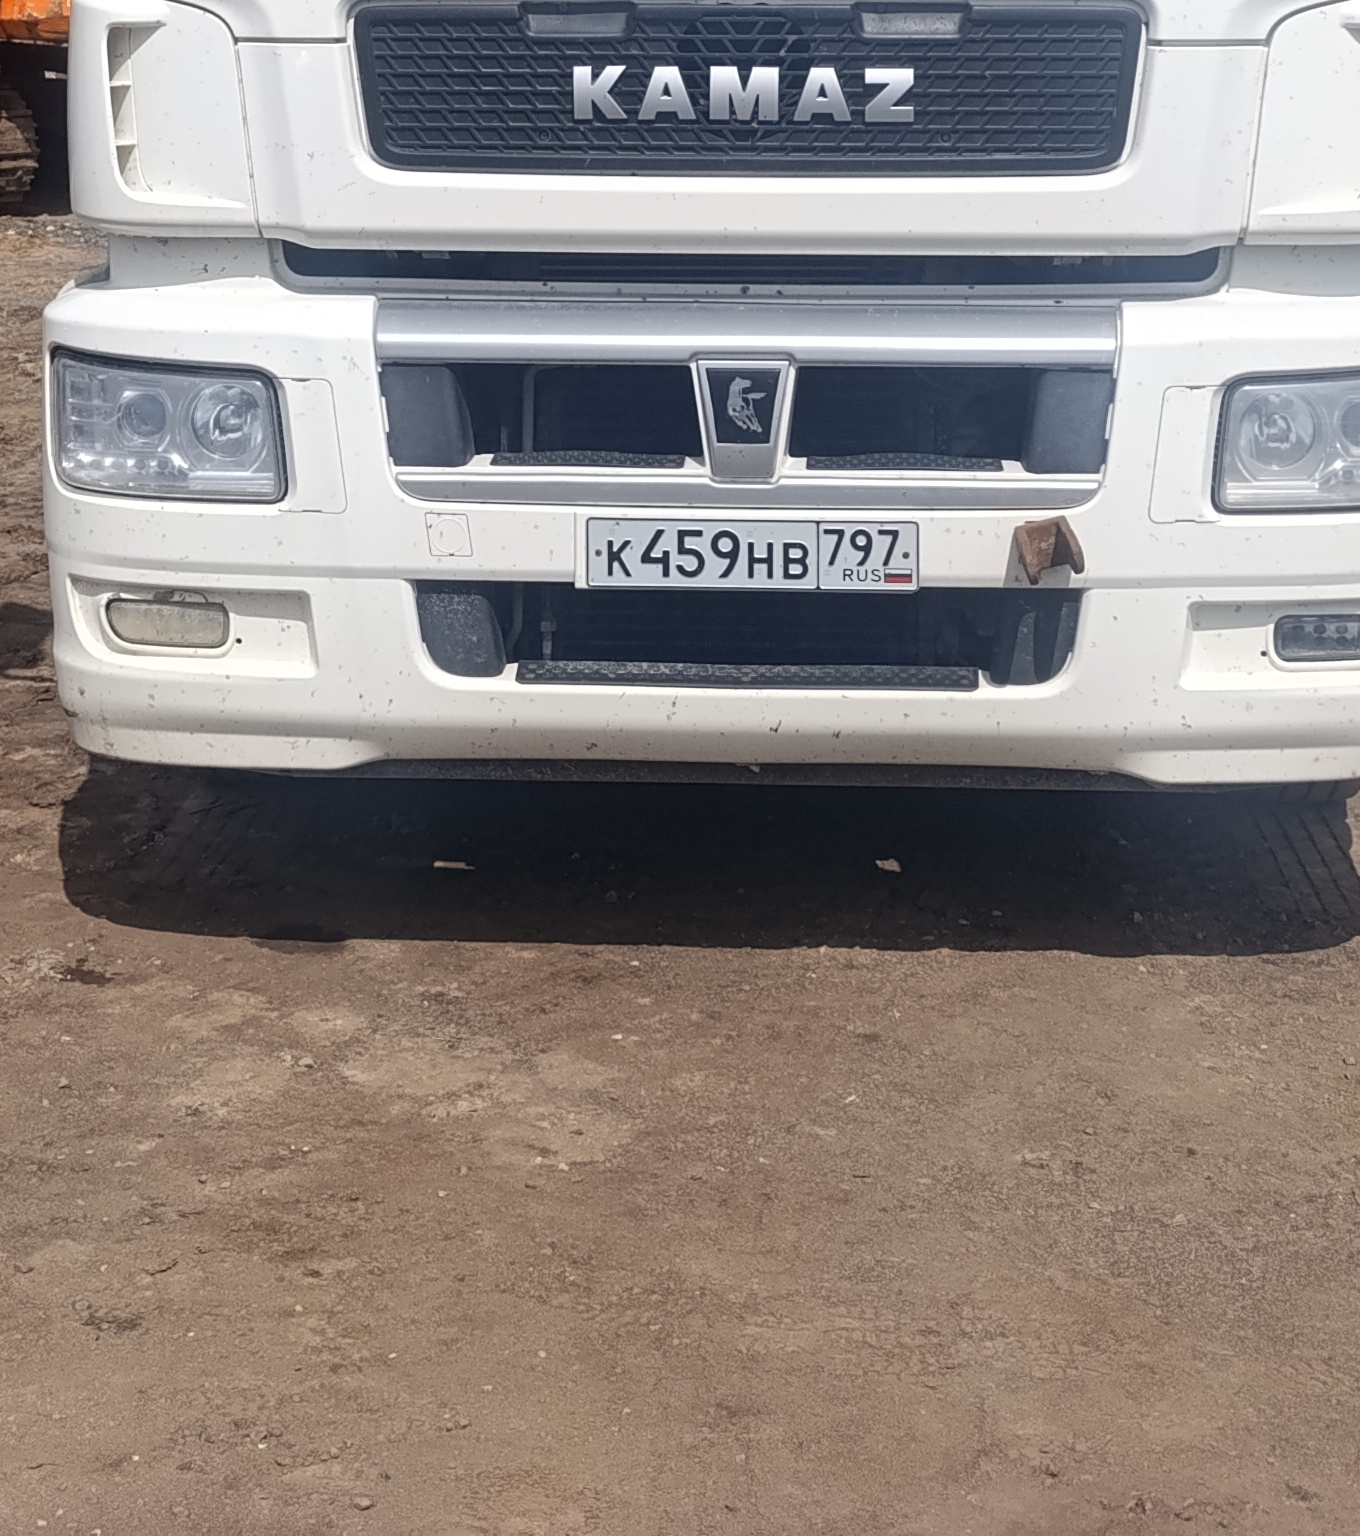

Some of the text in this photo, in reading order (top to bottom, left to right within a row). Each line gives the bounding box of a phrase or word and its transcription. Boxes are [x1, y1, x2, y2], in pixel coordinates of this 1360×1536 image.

[572, 64, 915, 123] KAMAZ
[606, 528, 900, 581] К459НВ 797
[842, 568, 883, 582] RUS
